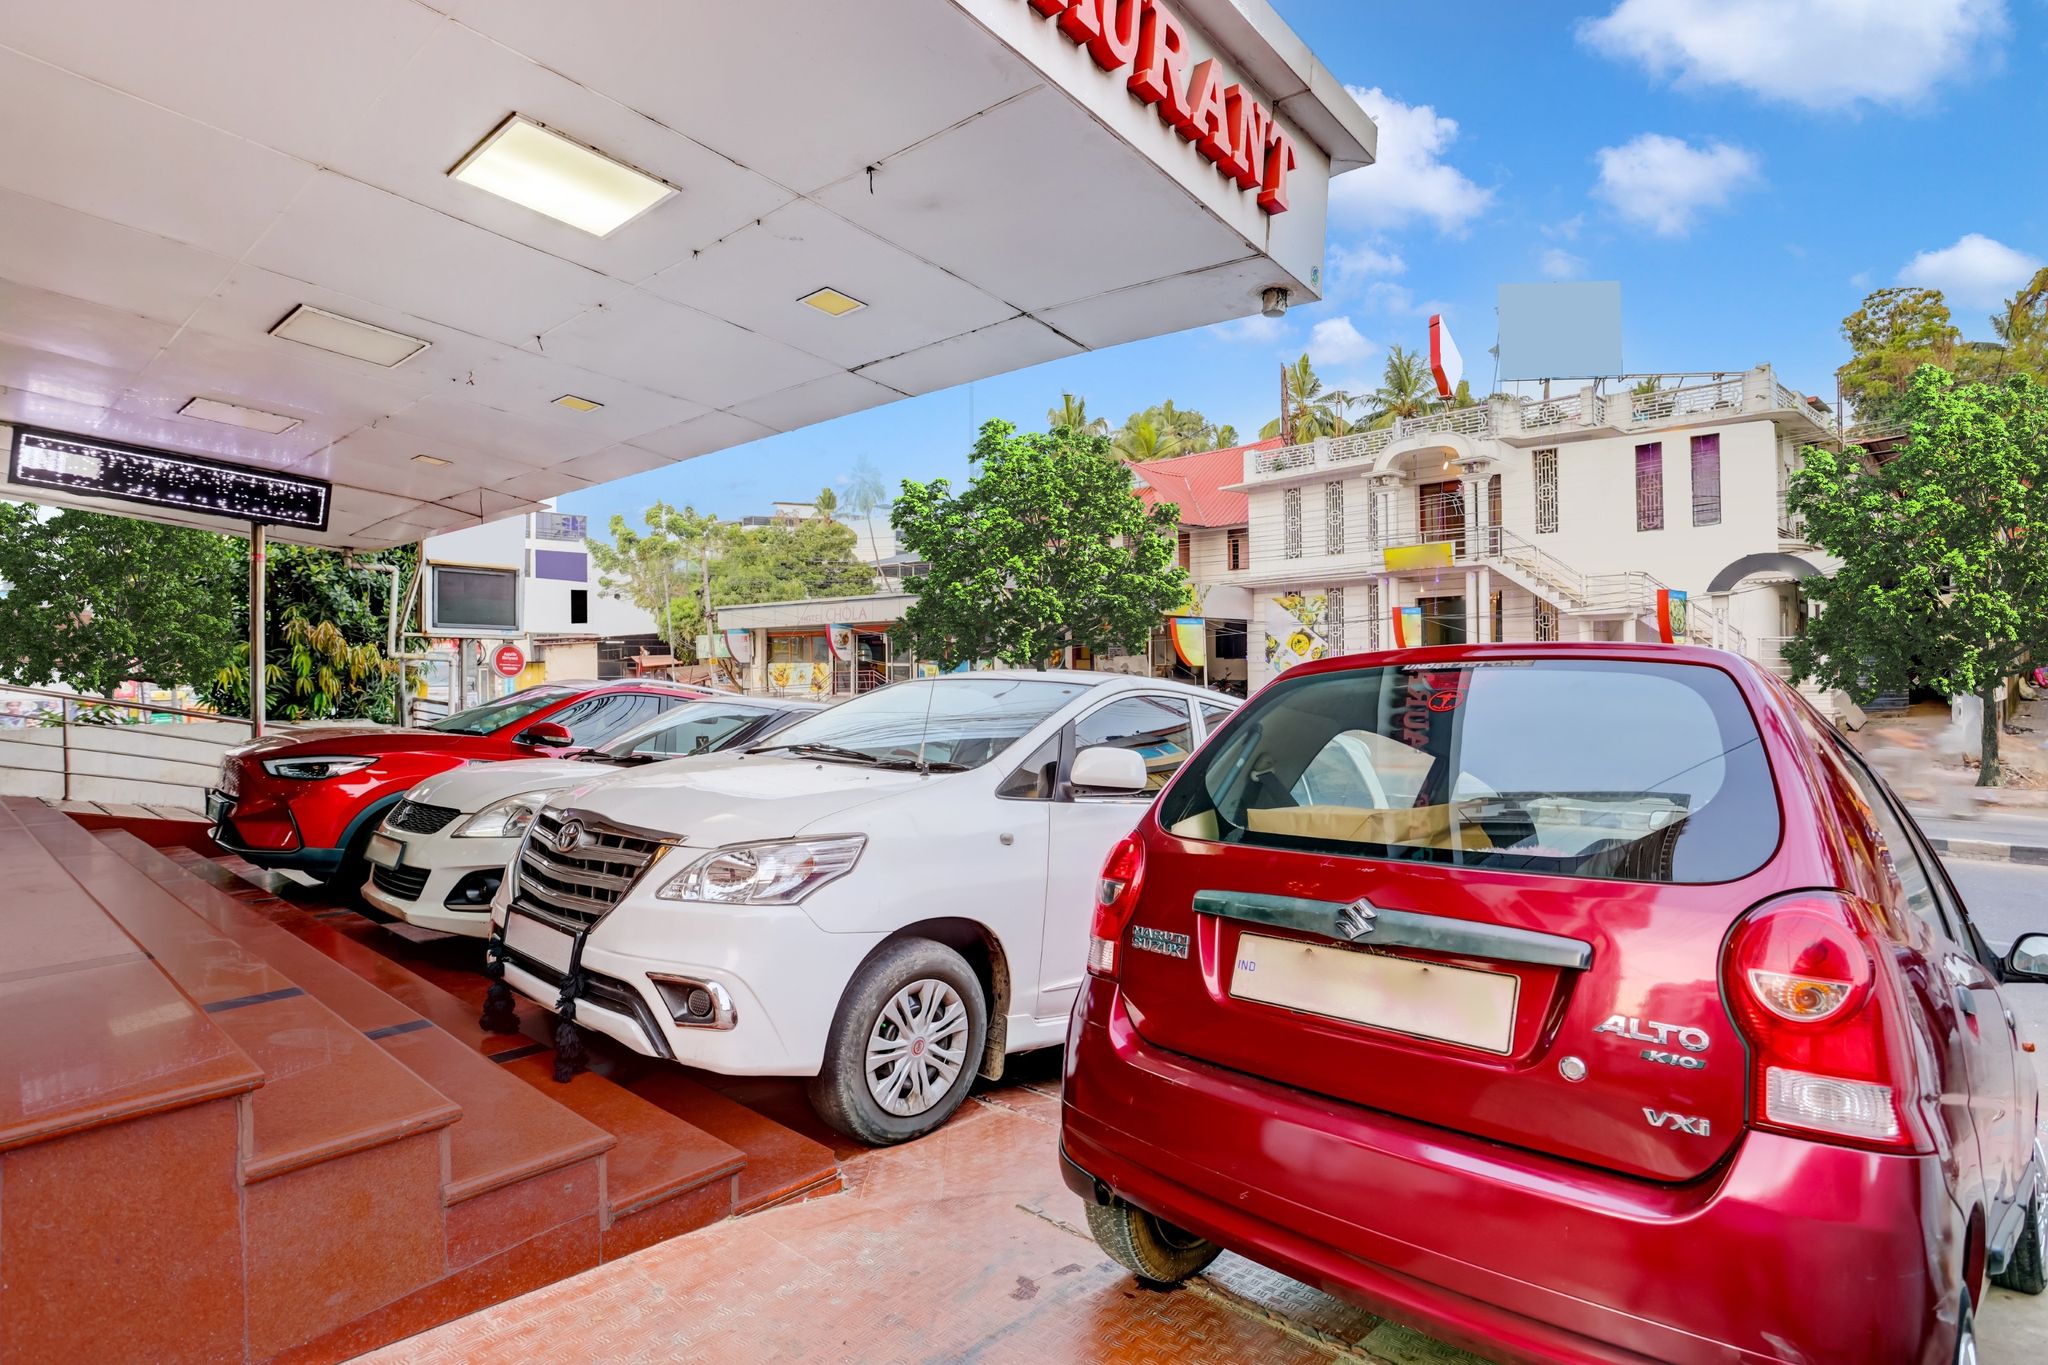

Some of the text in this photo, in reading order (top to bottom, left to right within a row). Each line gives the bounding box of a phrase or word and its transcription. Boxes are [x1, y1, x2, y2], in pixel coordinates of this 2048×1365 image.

[825, 606, 868, 622] CHOLA
[1132, 926, 1190, 944] MARUTI
[1132, 937, 1189, 959] SUZUKI
[1238, 959, 1256, 972] IND
[1593, 1014, 1710, 1052] ALTO
[1648, 1050, 1699, 1069] K10
[1642, 1107, 1711, 1137] VXi
